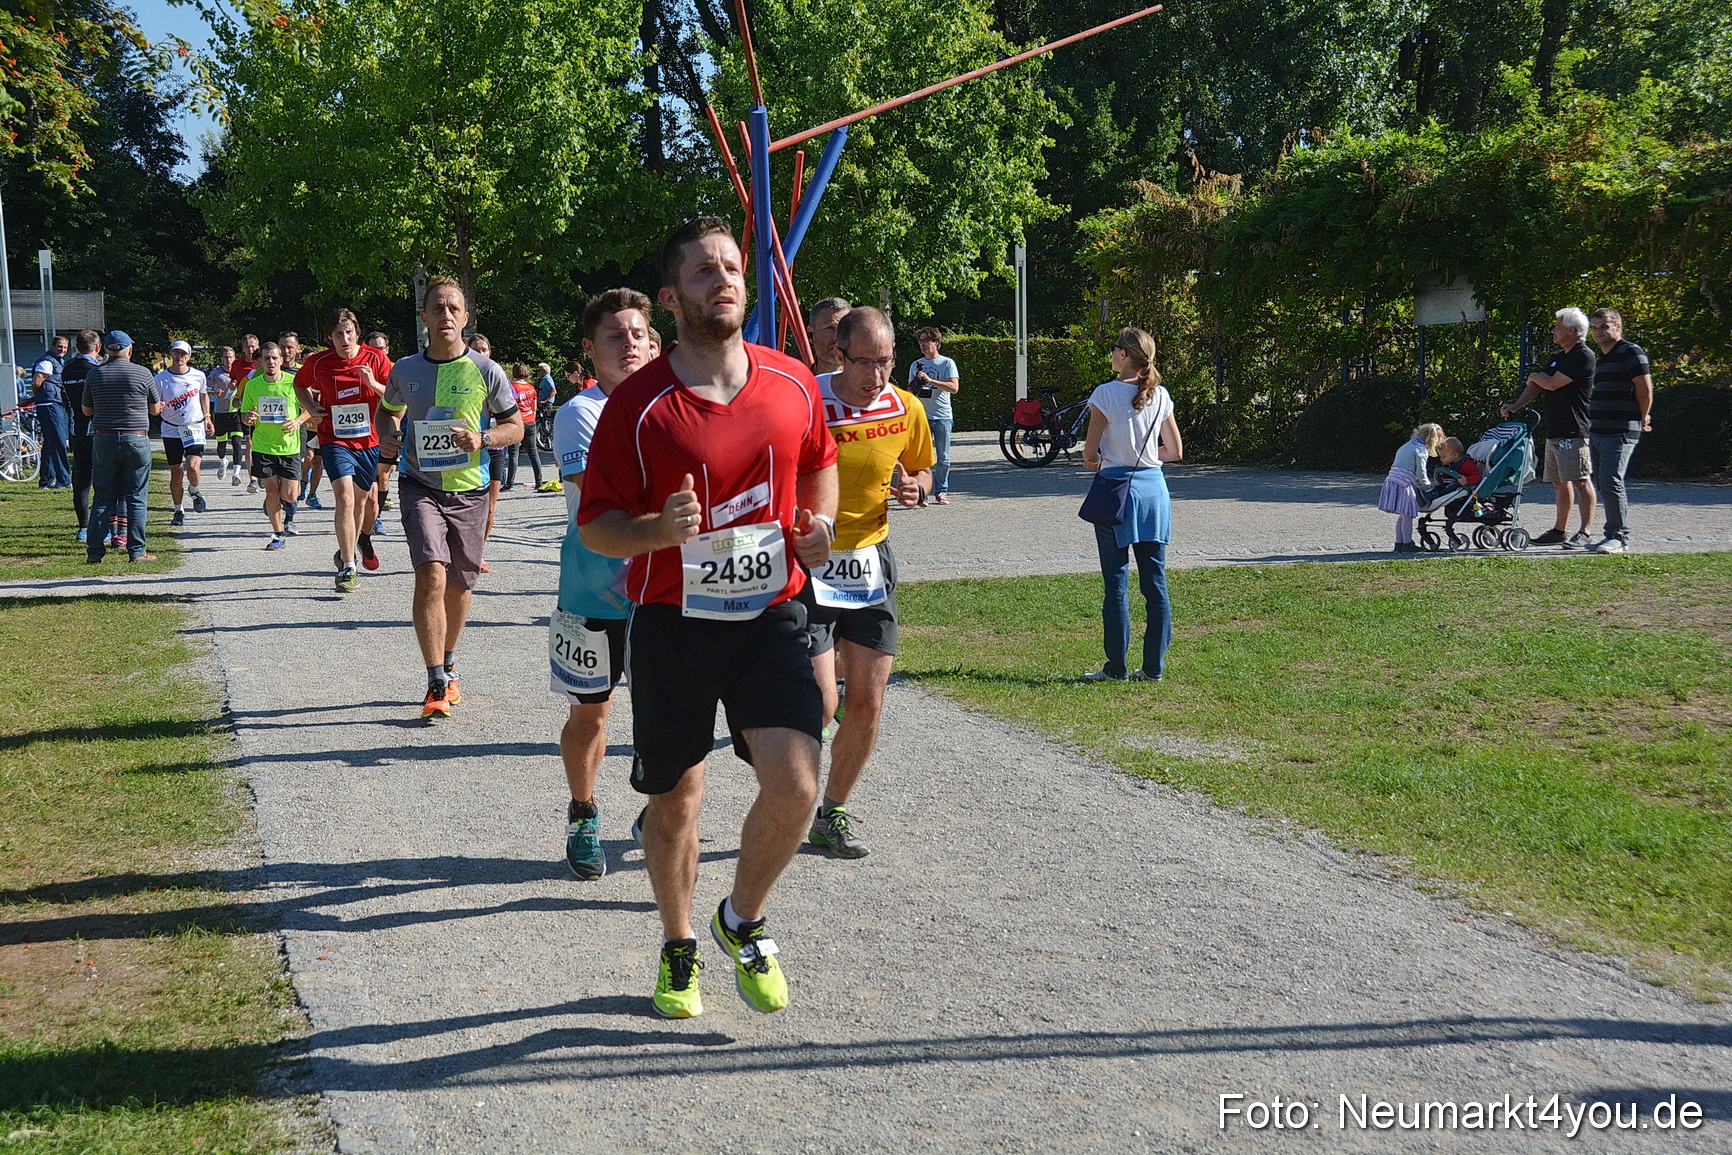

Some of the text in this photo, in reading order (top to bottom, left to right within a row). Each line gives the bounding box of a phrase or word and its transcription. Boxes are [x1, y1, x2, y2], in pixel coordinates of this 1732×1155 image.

[167, 388, 199, 408] FINISHER
[171, 399, 188, 411] 2017
[262, 404, 284, 413] 2174
[338, 412, 365, 425] 2439
[835, 422, 907, 444] AX BÖGL
[1558, 438, 1573, 451] 86
[430, 457, 457, 466] Thomas
[728, 495, 753, 515] DEHN
[712, 533, 756, 552] BOCK
[700, 551, 772, 585] 2438
[821, 558, 872, 580] 2404
[706, 585, 759, 595] PARTL Neumarkt
[833, 592, 868, 601] Andreas
[723, 600, 750, 611] Max
[555, 633, 598, 669] 2146
